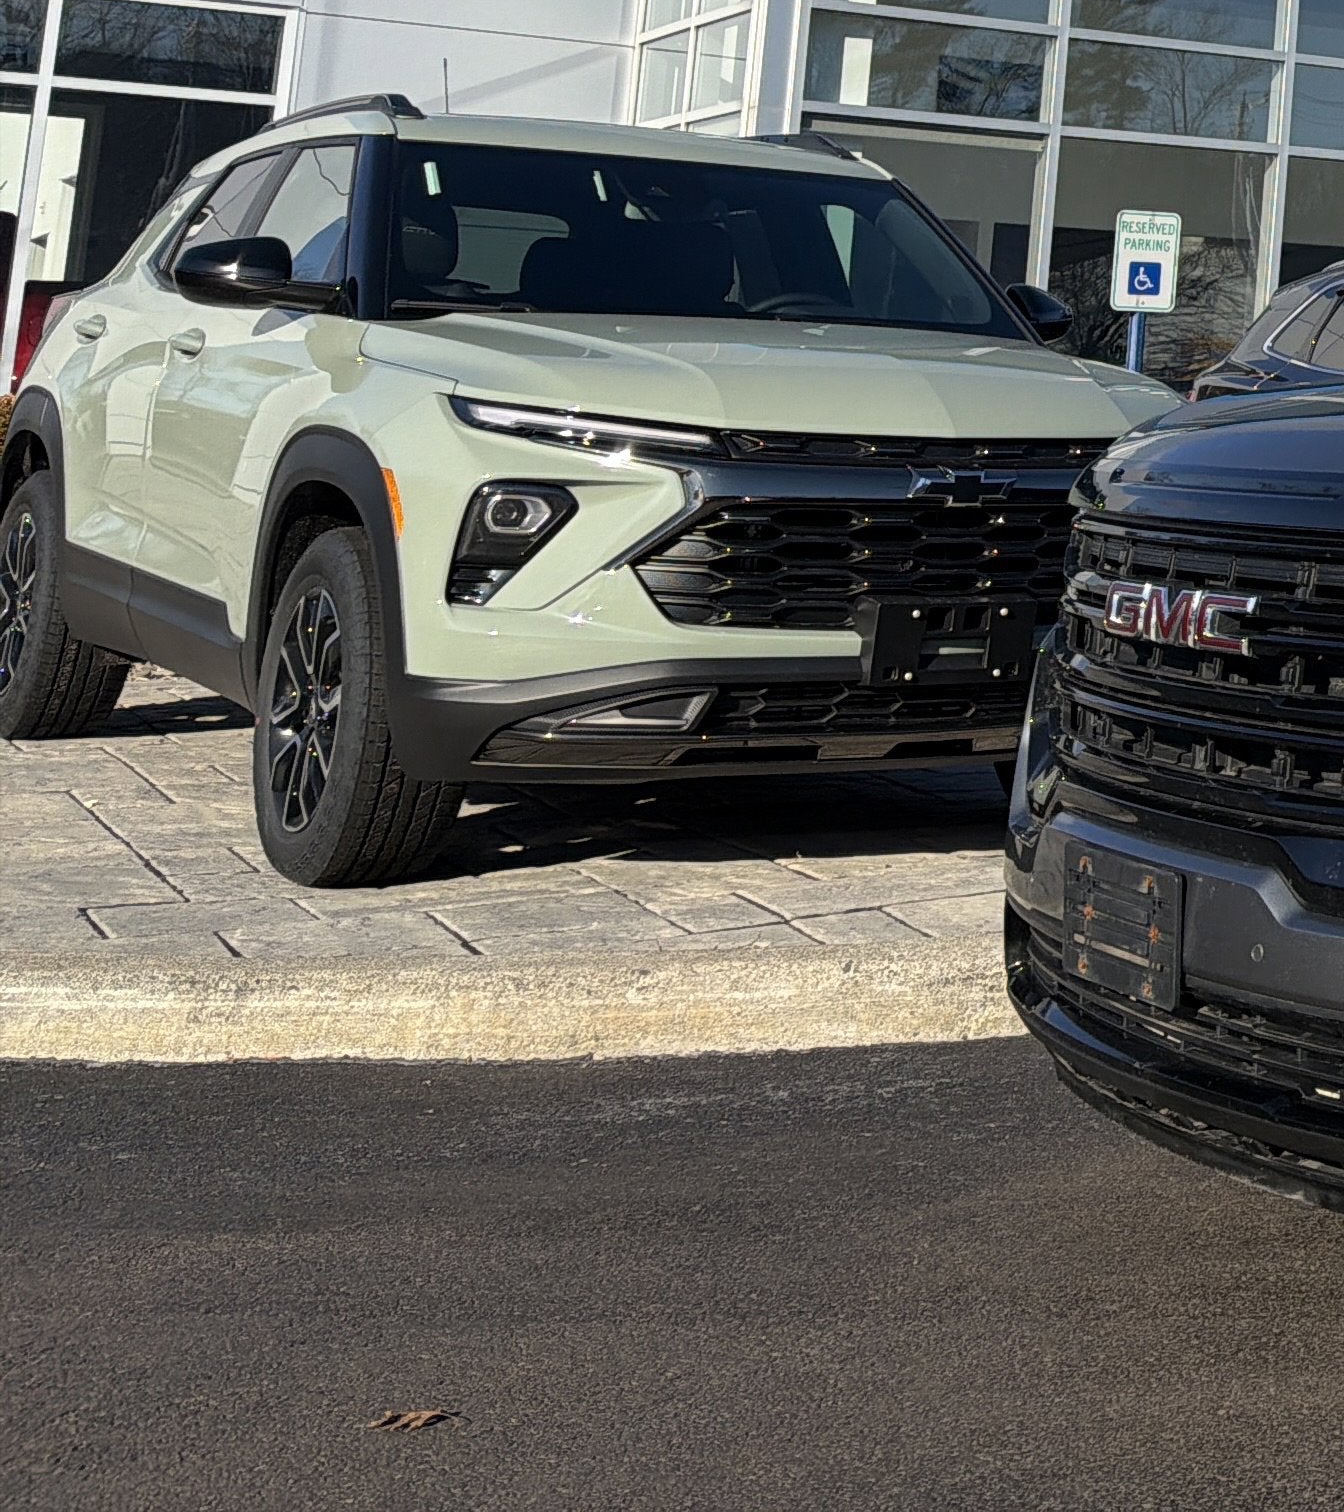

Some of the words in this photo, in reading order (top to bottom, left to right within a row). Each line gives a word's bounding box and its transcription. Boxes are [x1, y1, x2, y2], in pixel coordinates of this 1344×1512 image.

[1121, 220, 1176, 236] RESERVED
[1124, 237, 1171, 252] PARKING
[1105, 581, 1258, 656] GMC
